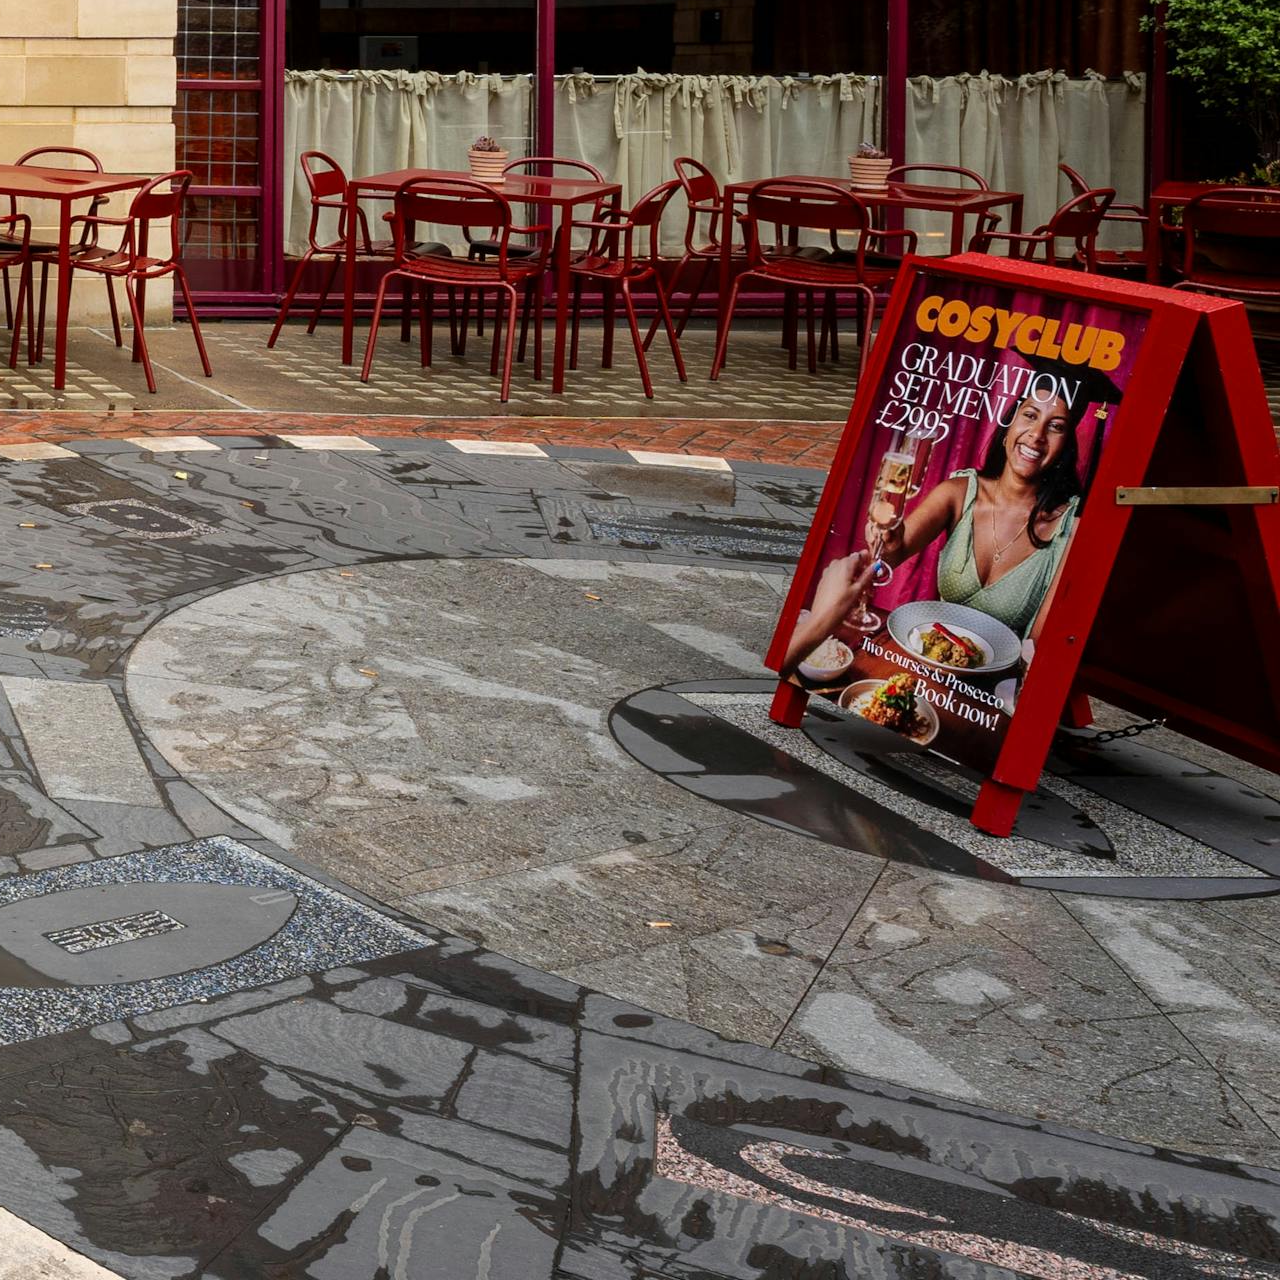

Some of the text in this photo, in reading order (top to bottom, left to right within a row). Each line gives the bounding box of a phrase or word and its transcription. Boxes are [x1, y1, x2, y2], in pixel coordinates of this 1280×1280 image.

[916, 295, 1125, 371] COSYCLUB
[889, 371, 1023, 428] SET MENU
[901, 342, 1082, 411] GRADUATION
[875, 400, 955, 445] £29.95
[861, 635, 1005, 710] Two courses & Prosecco
[913, 678, 1001, 732] Book now!
